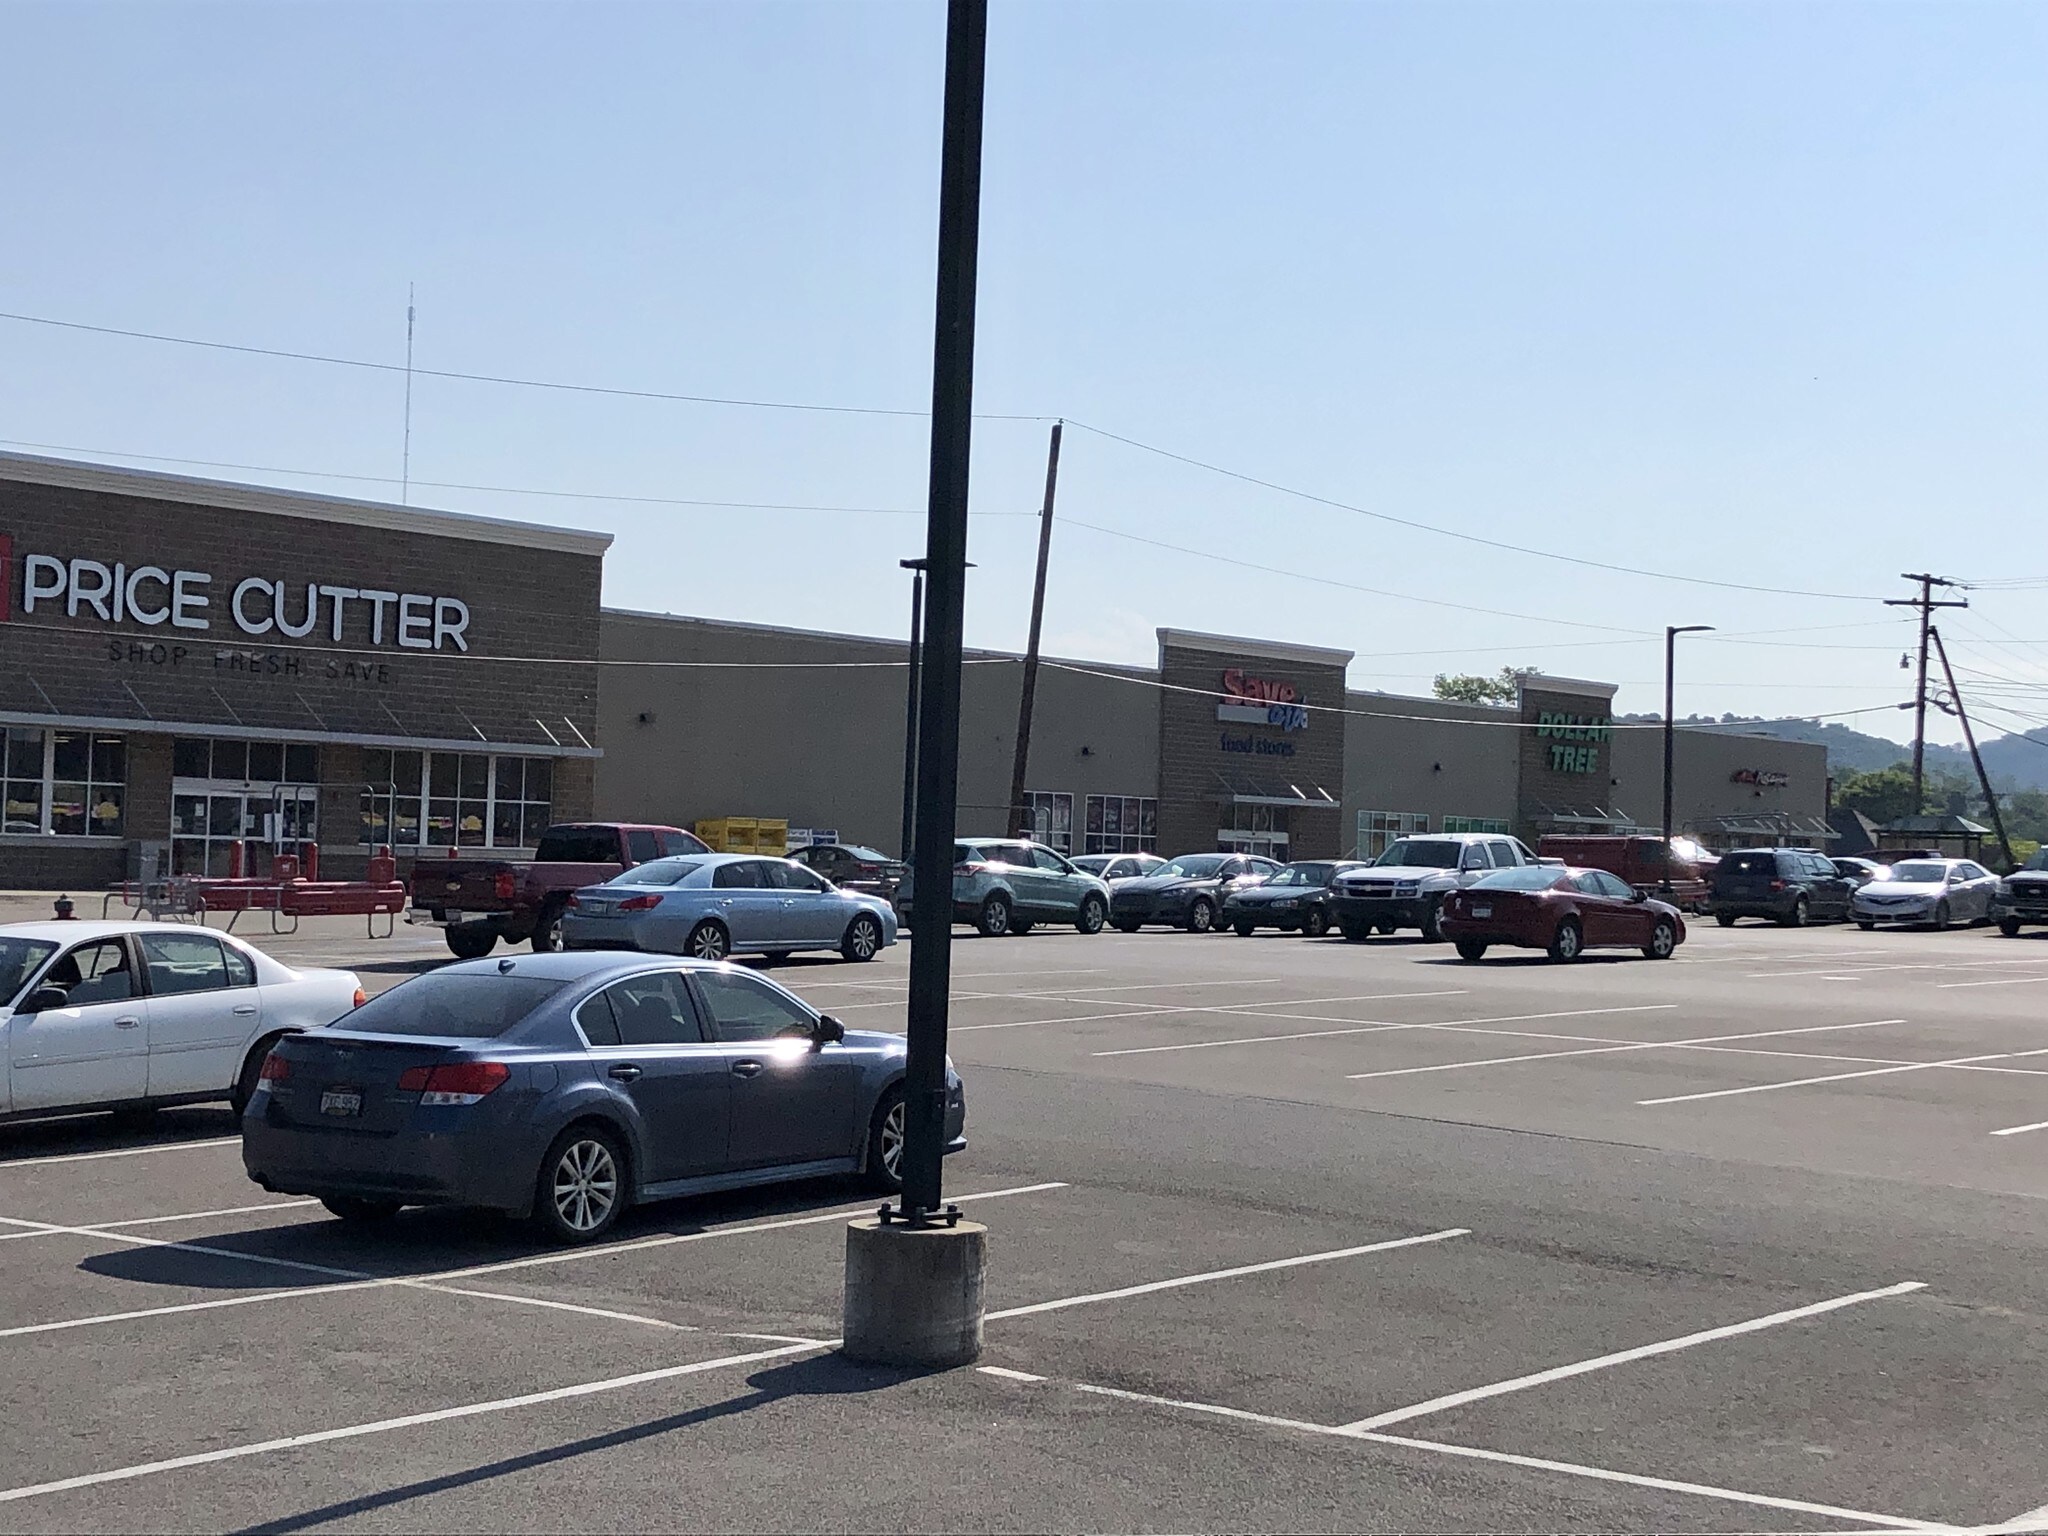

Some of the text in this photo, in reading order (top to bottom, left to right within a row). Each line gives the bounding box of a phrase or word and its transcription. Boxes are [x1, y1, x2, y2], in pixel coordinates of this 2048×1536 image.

[23, 553, 471, 653] PRICE CUTTER
[109, 640, 392, 684] SHOP FRESH SAVE
[1223, 667, 1296, 708] Save
[1220, 732, 1253, 753] food
[1537, 711, 1614, 743] DOLLAR
[1550, 744, 1599, 774] TREE
